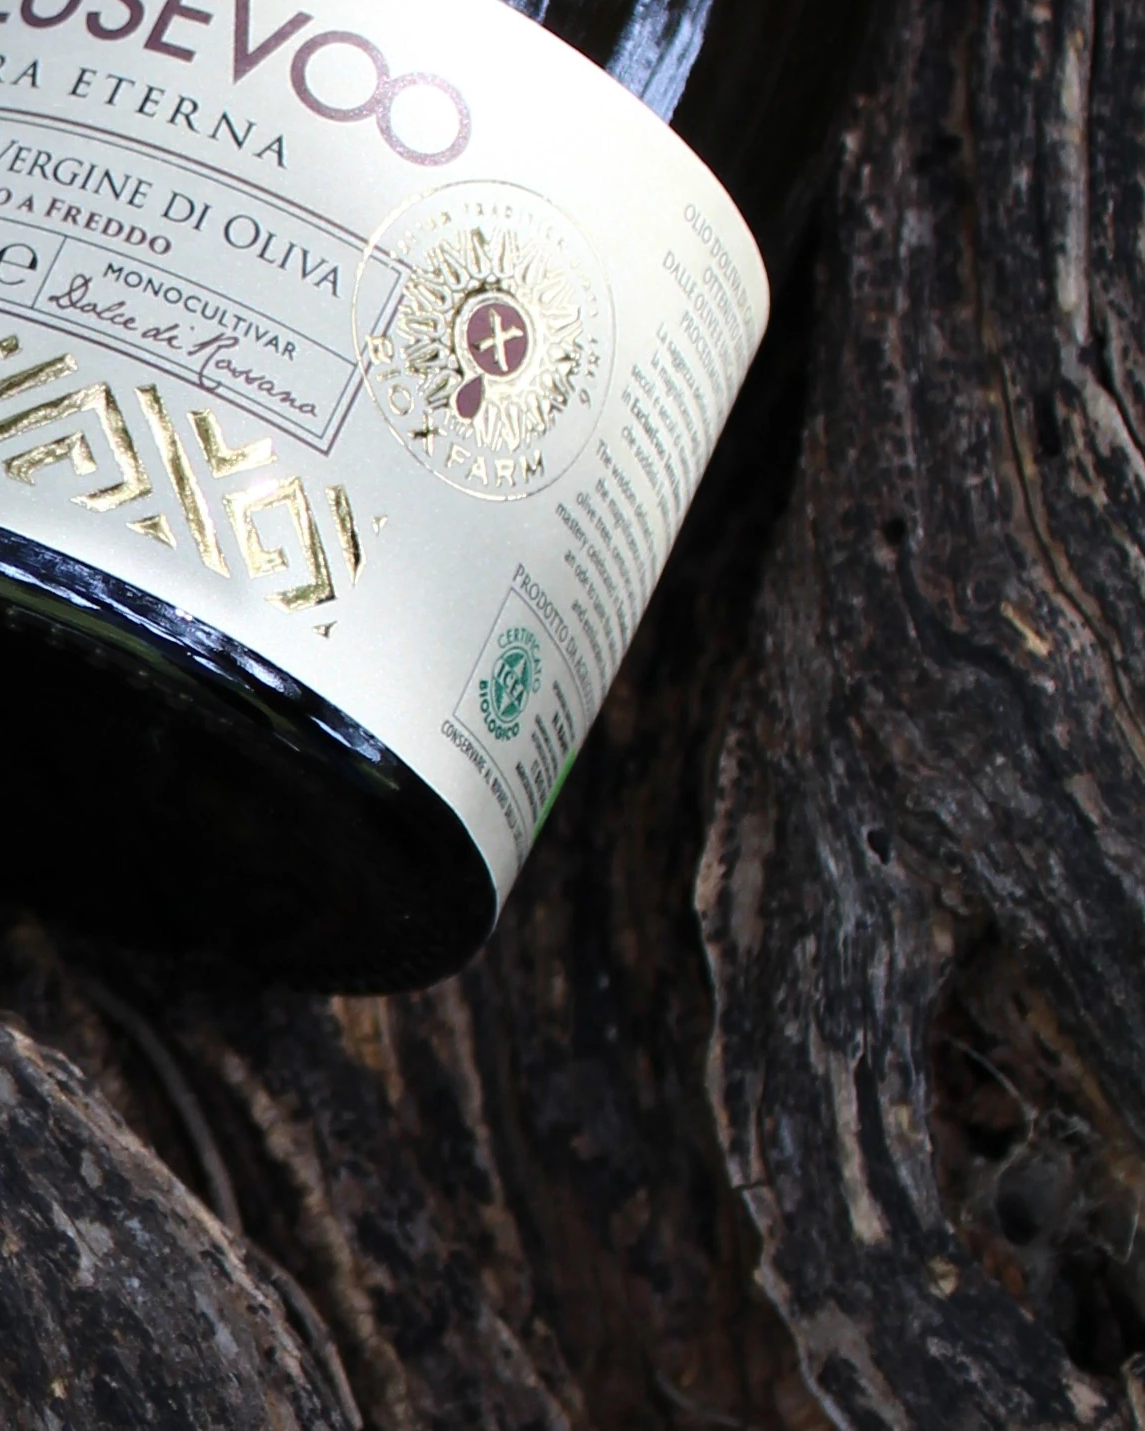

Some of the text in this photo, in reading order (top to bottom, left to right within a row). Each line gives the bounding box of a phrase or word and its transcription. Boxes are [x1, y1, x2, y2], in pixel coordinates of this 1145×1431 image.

[67, 67, 288, 168] ETERNA
[17, 194, 35, 213] A
[44, 196, 173, 256] FREDDO
[160, 190, 213, 231] DI
[223, 214, 342, 299] OLIVA
[683, 204, 713, 245] OLIO
[48, 272, 139, 331] Dolce
[662, 250, 698, 301] DALLE
[102, 262, 297, 361] MONOCULTIVAR
[444, 443, 546, 488] FARM
[596, 438, 613, 470] The
[576, 490, 597, 523] olive
[595, 477, 610, 503] the
[555, 502, 590, 550] mastery
[512, 562, 569, 644] PRODOTTO
[497, 627, 542, 694] CERTIFICATO
[497, 661, 524, 708] ICEA
[479, 679, 521, 741] BIOLOGICO
[441, 719, 487, 775] CONSERVARE
